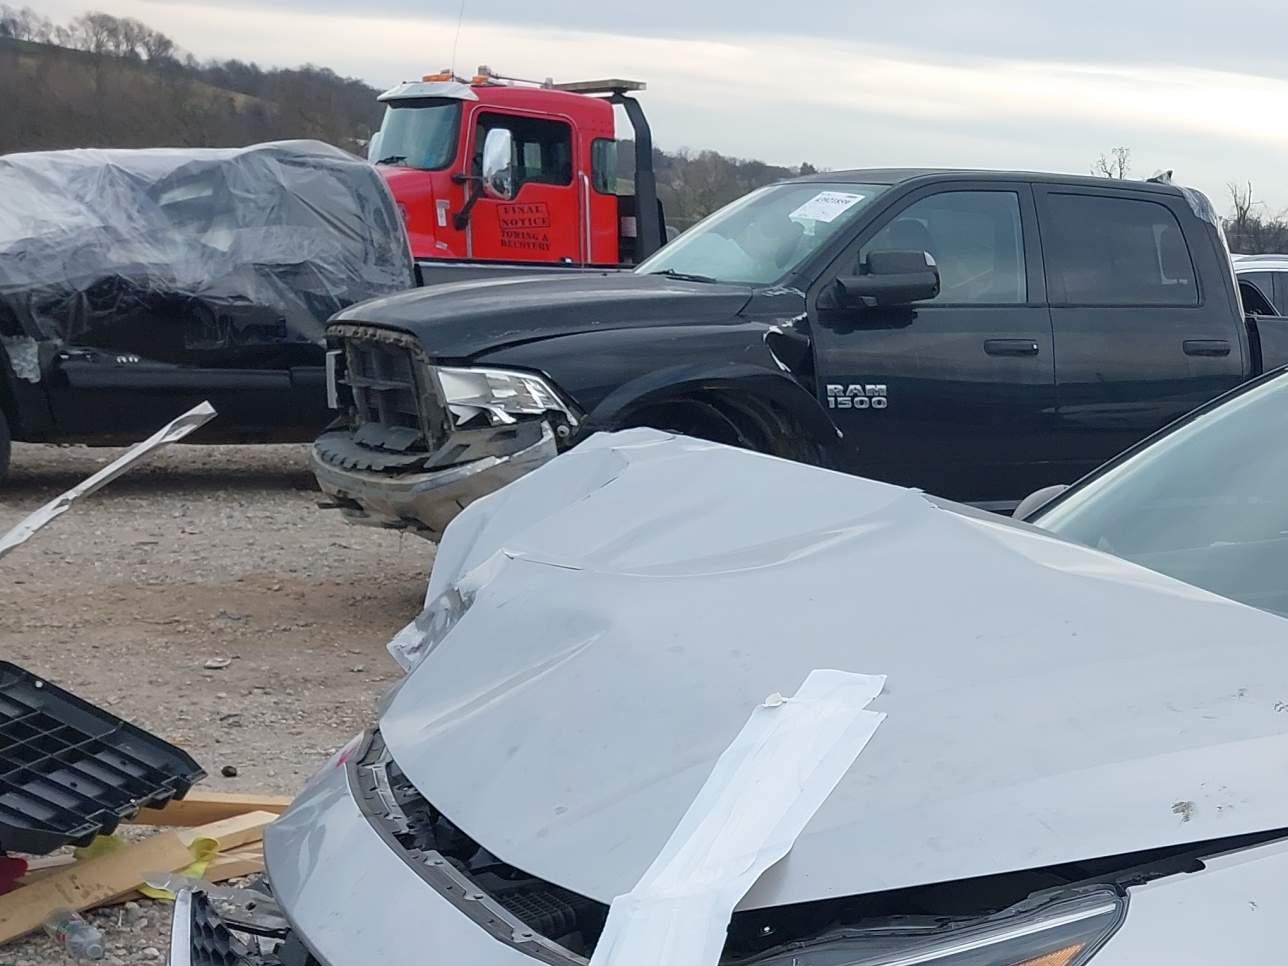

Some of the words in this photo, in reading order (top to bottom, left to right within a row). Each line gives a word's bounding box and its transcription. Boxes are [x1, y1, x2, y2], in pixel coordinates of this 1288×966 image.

[504, 206, 542, 214] FINAL
[503, 217, 546, 226] NOTICE
[501, 231, 538, 241] TOWING
[501, 240, 550, 251] RECOVERY
[826, 384, 888, 396] RAM
[827, 396, 888, 409] 1500
